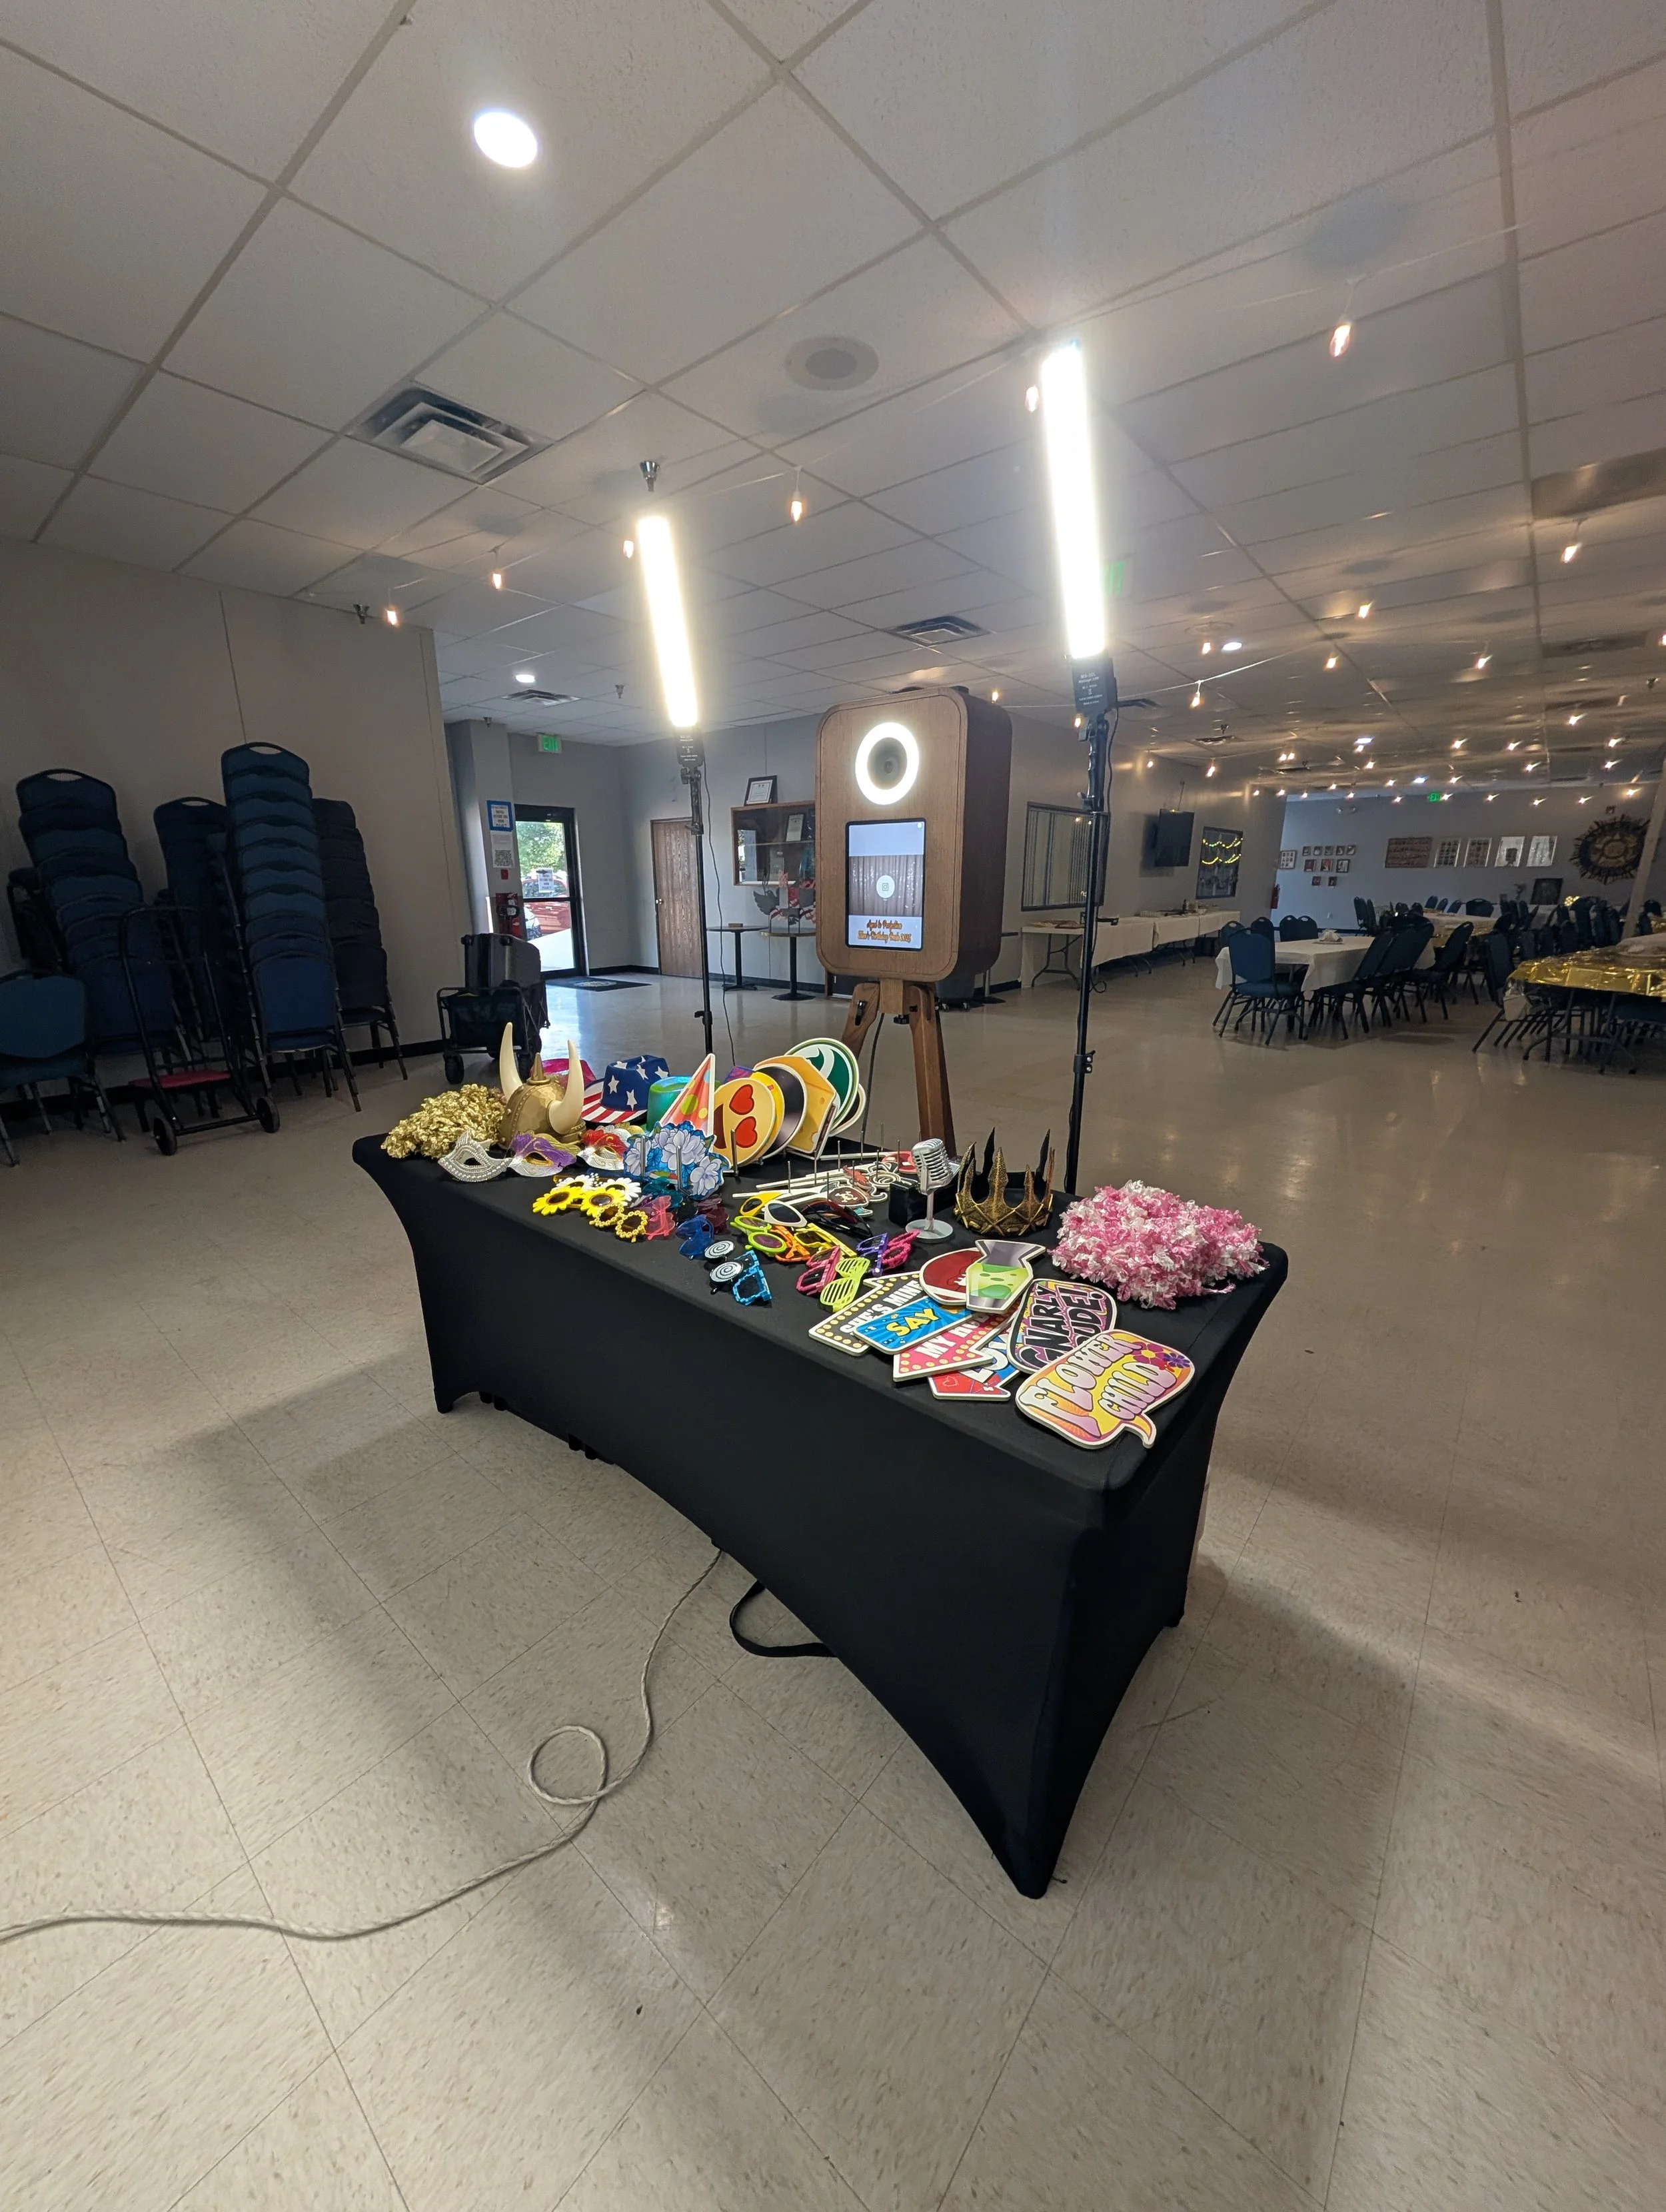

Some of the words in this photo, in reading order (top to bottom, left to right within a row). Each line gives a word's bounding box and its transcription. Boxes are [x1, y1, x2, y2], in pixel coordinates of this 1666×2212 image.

[886, 1308, 940, 1337] SAY
[914, 1335, 956, 1359] MY
[1019, 1283, 1076, 1370] GNARLY
[1018, 1334, 1144, 1438] FLOWER
[1098, 1362, 1177, 1420] CHILD
